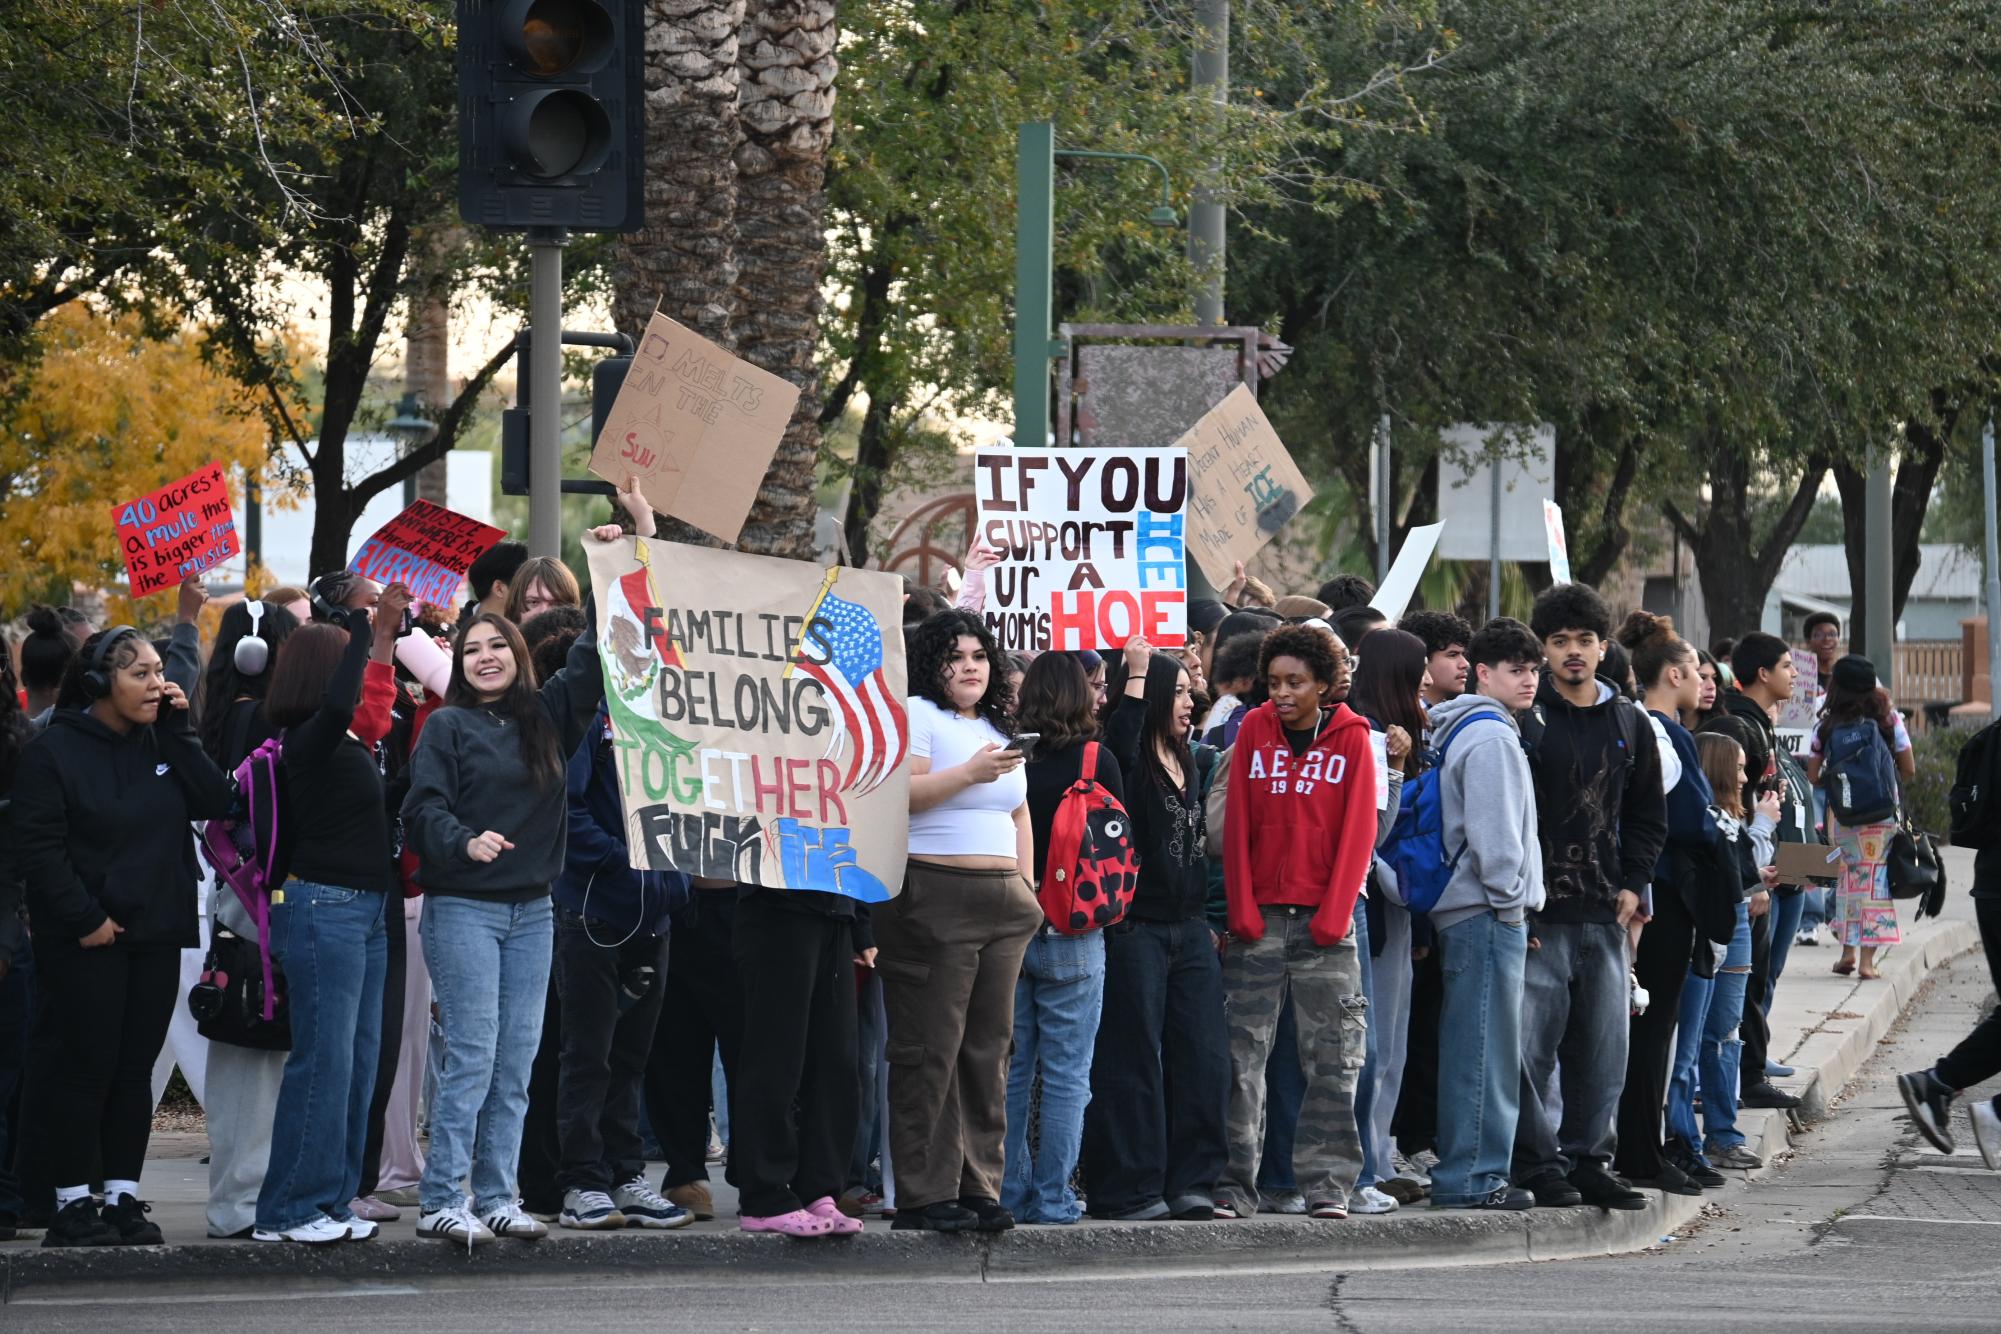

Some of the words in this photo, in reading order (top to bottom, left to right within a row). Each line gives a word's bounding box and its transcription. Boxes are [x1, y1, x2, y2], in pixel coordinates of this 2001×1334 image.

[672, 349, 764, 412] MELTS
[676, 385, 724, 426] THE
[622, 432, 656, 468] SUN
[1217, 415, 1260, 450] HUMAN
[119, 498, 157, 529] 40
[159, 476, 211, 512] acres
[978, 454, 1049, 512] IF
[1055, 456, 1186, 513] YOU
[1193, 495, 1216, 520] HAS
[1216, 477, 1228, 495] A
[1227, 445, 1265, 483] HEART
[1199, 527, 1234, 557] MADE
[1235, 505, 1248, 526] OF
[1244, 463, 1284, 513] ICE
[126, 536, 145, 554] a
[145, 511, 198, 548] mule
[201, 497, 228, 521] this
[130, 555, 148, 572] is
[154, 530, 207, 566] bigger
[210, 520, 235, 541] than
[374, 526, 421, 554] threat
[418, 541, 430, 557] to
[408, 501, 487, 537] INJUSTICE
[138, 572, 168, 593] the
[178, 539, 230, 577] music
[348, 538, 463, 609] EVERYWHERE
[459, 539, 473, 554] IS
[470, 545, 484, 558] A
[1067, 562, 1105, 590] A
[1136, 511, 1186, 589] ICE
[643, 606, 834, 666] FAMILIES
[985, 606, 1051, 650] MOM'S
[1051, 590, 1185, 651] HOE
[659, 666, 830, 737] BELONG
[615, 738, 848, 826] TOGETHER
[1248, 750, 1347, 784] AERO
[632, 803, 764, 885] FUCK
[772, 817, 889, 903] ICE
